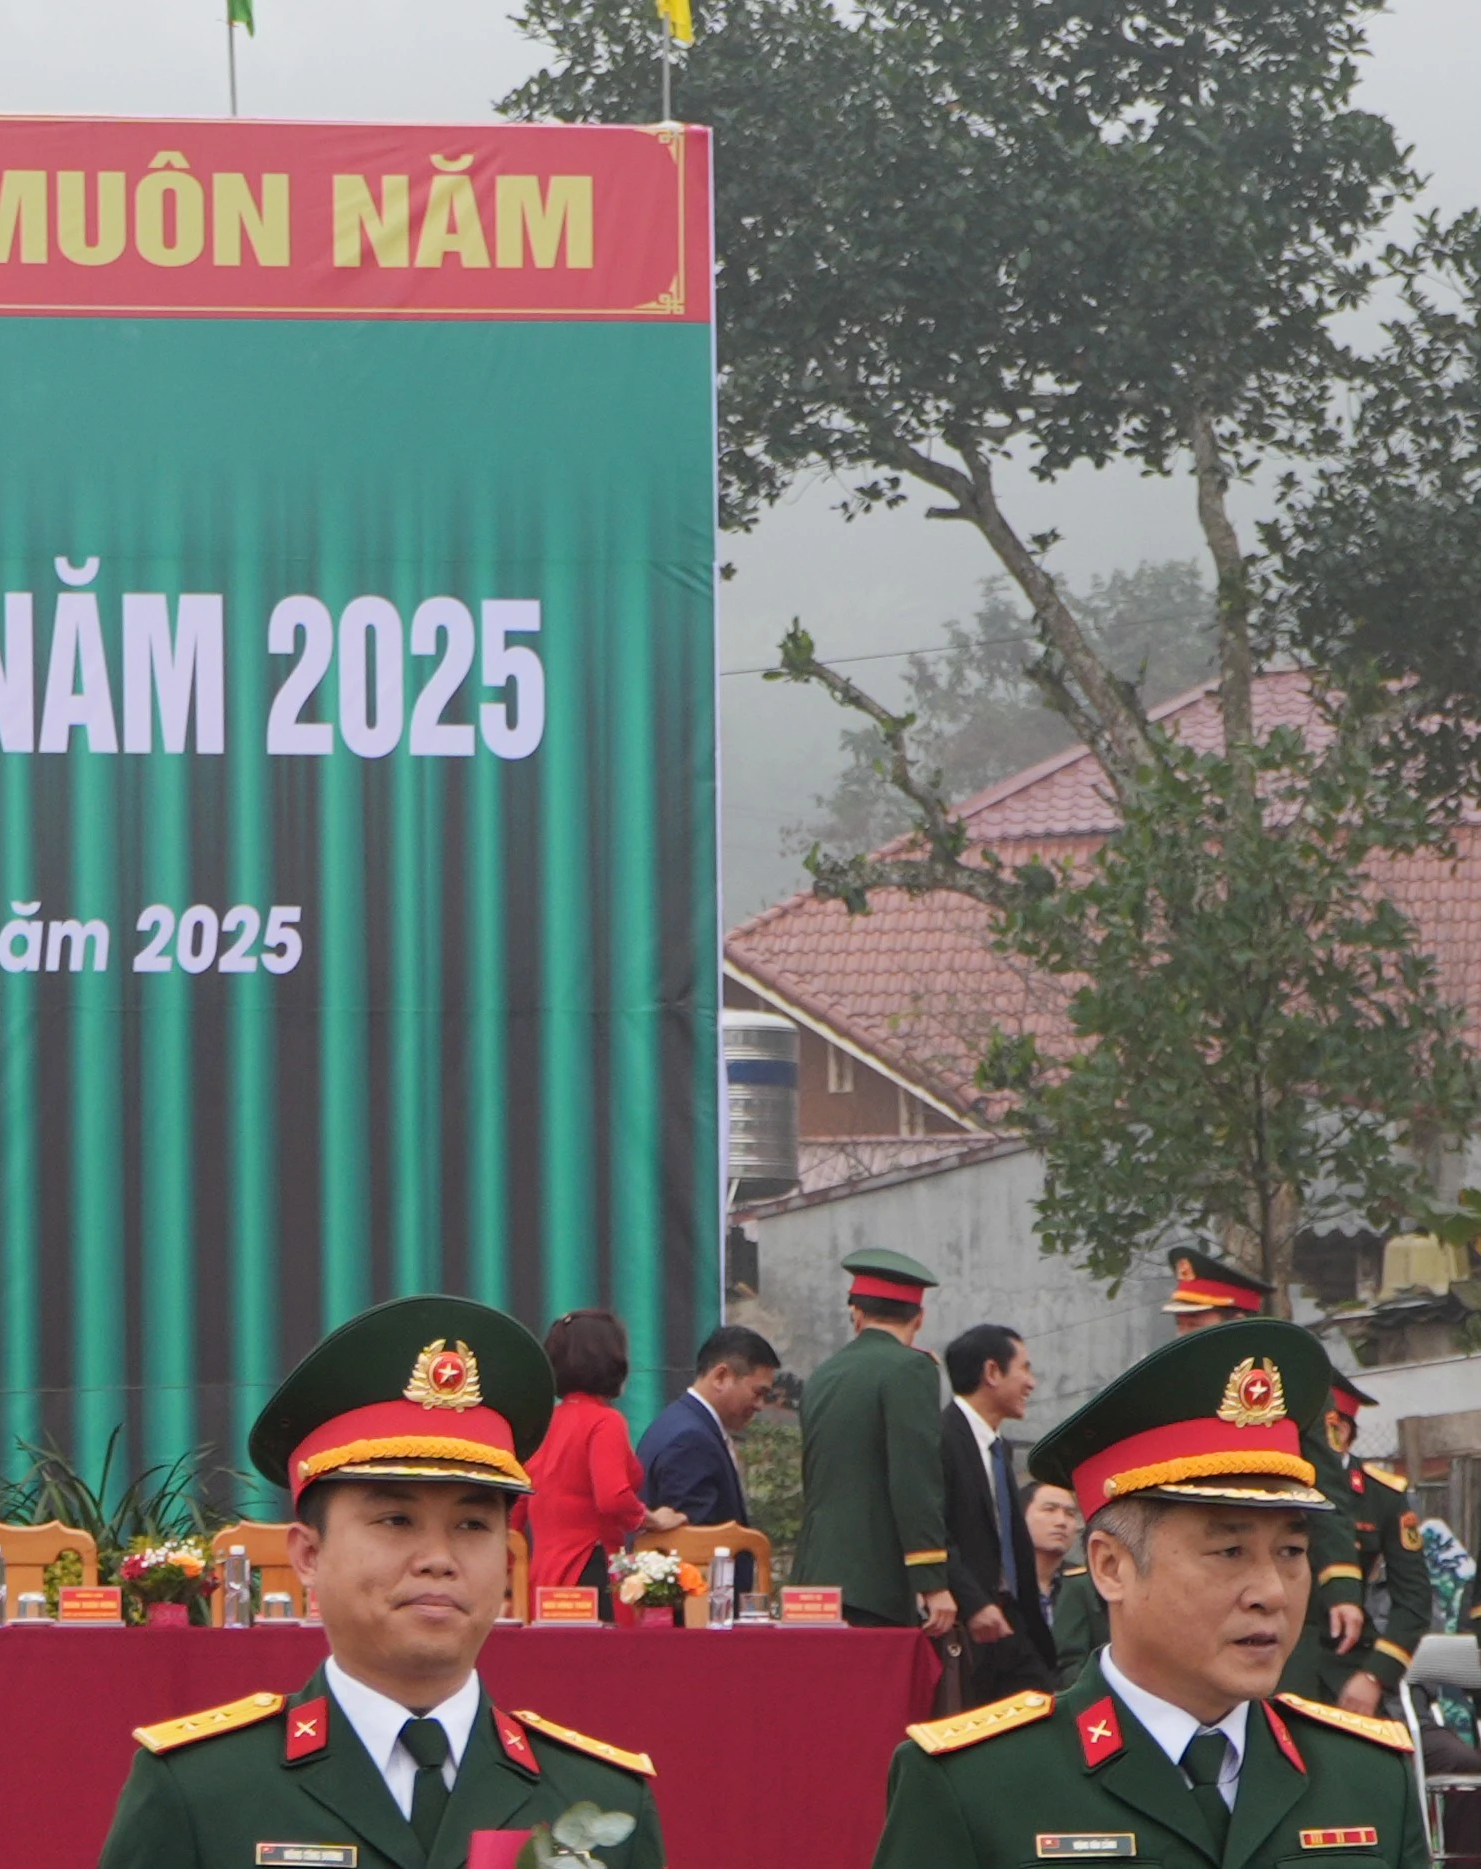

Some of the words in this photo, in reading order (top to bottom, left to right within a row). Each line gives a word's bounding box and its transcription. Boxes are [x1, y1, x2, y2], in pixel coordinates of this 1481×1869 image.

[331, 153, 595, 270] NĂM
[266, 593, 543, 760] 2025
[131, 902, 303, 976] 2025
